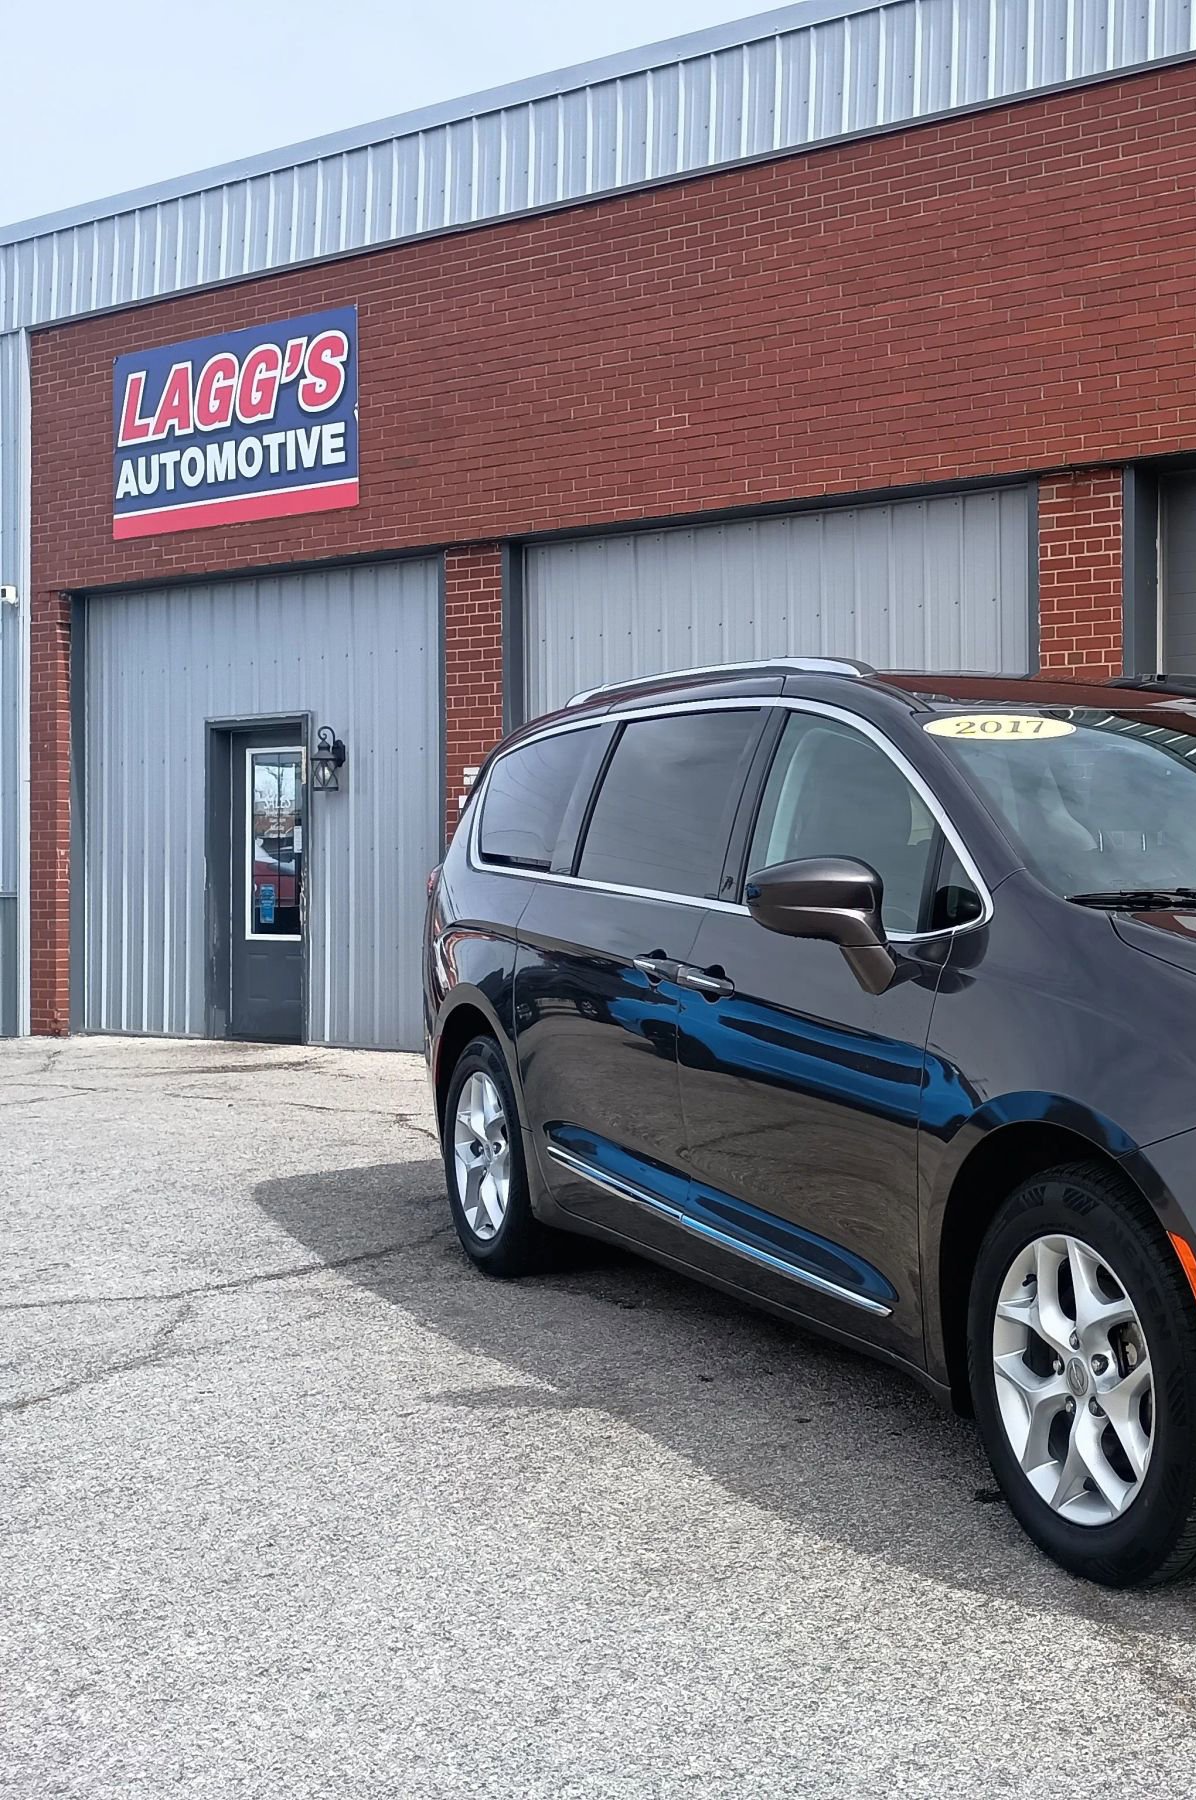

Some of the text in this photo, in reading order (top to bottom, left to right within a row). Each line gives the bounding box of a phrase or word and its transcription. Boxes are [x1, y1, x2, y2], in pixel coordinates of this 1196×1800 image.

[117, 329, 349, 448] LAGG'S
[115, 421, 346, 500] AUTOMOTIVE
[954, 719, 1045, 735] 2017
